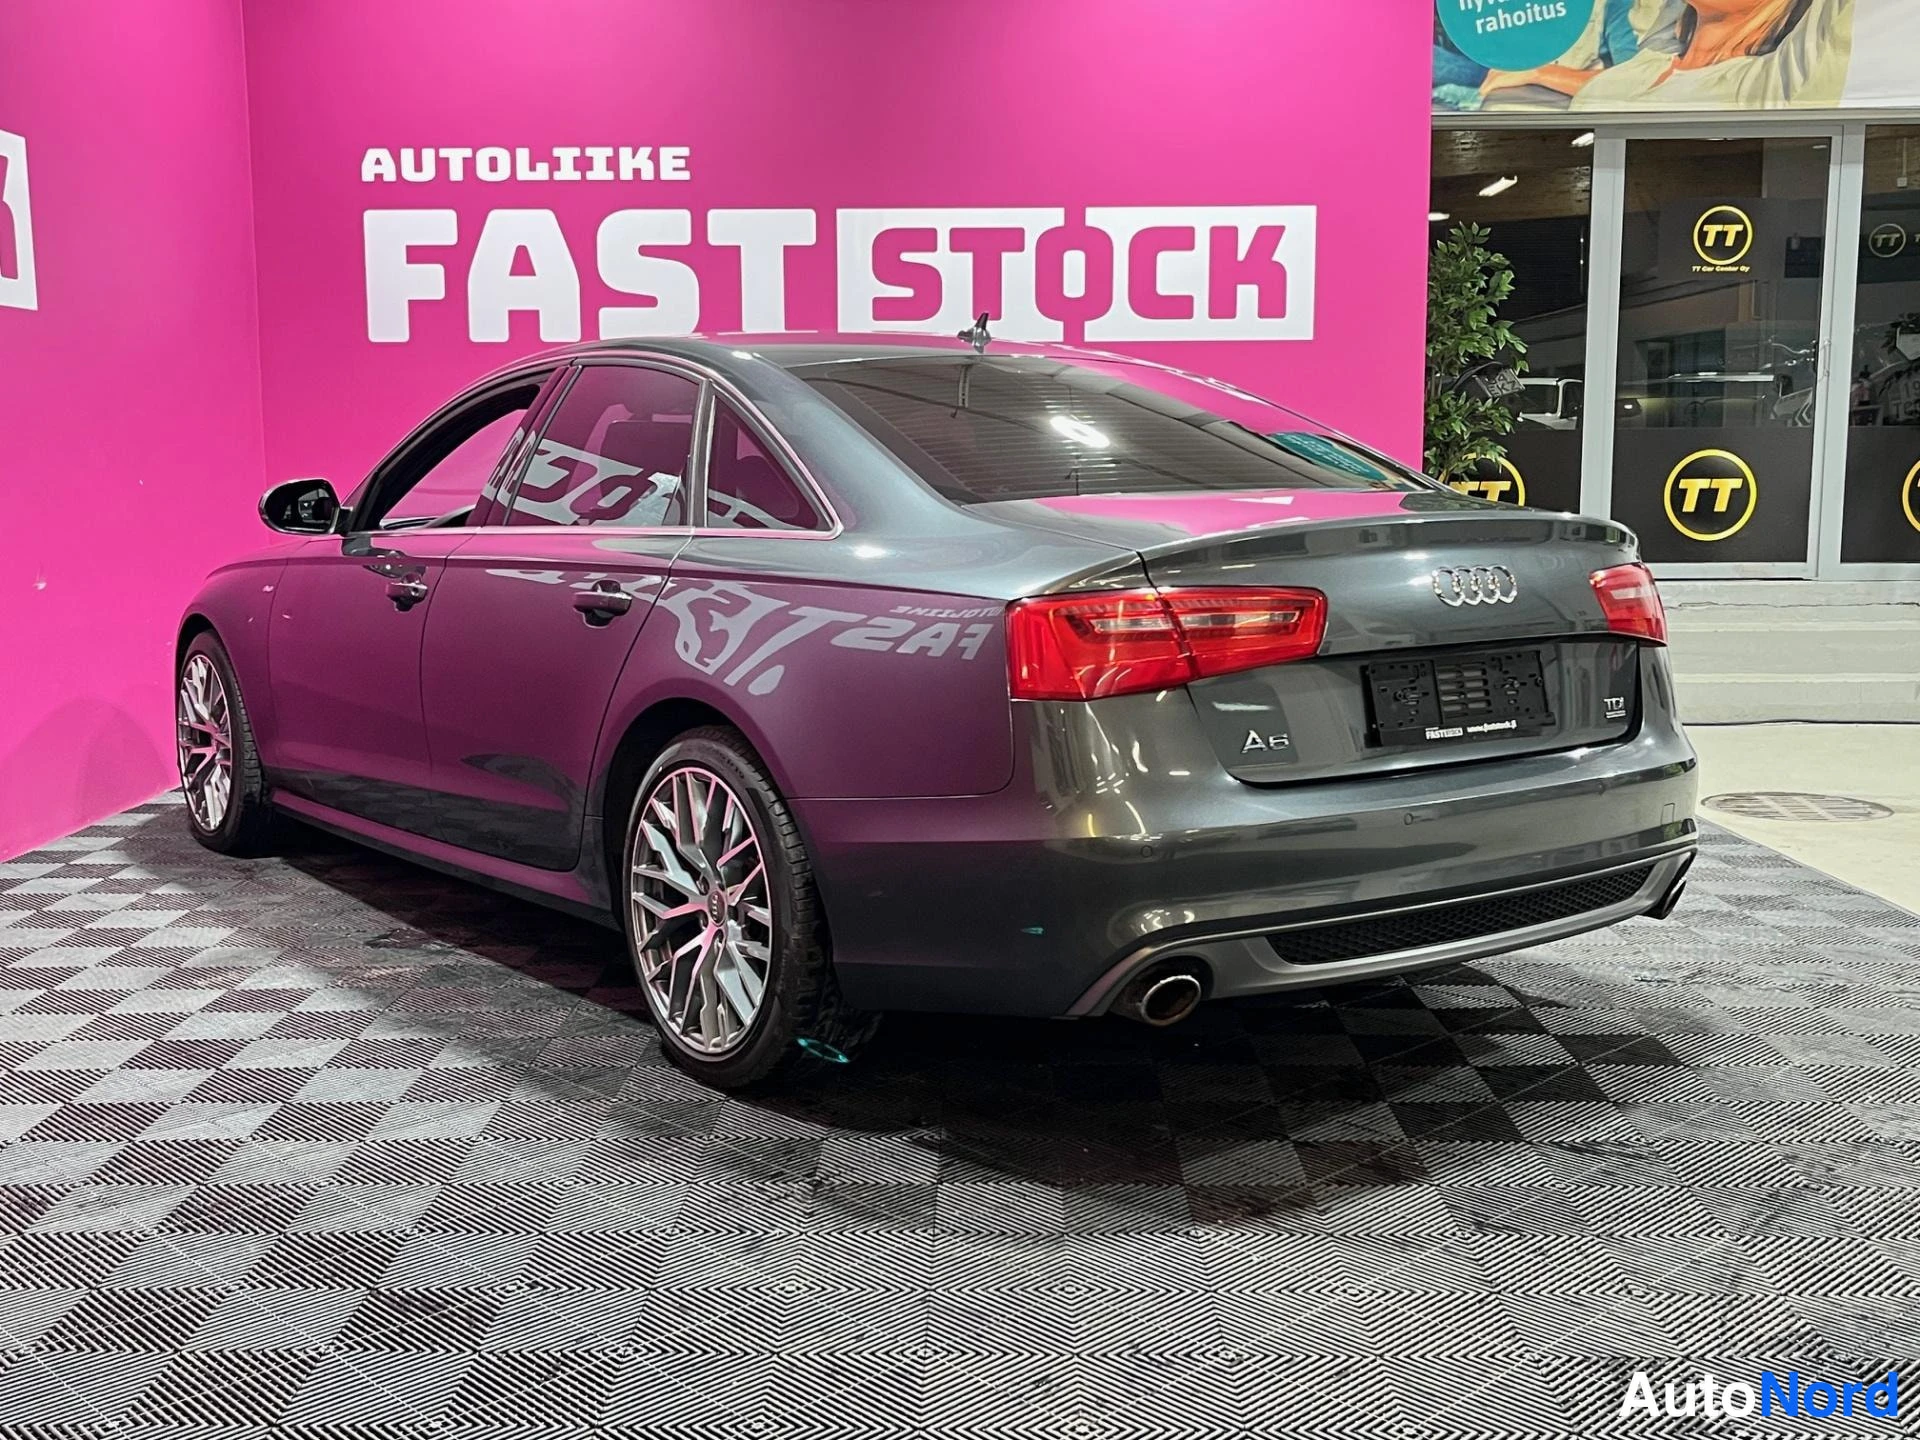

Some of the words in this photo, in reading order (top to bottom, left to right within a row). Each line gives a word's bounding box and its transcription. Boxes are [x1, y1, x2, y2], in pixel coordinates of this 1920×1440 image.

[1475, 1, 1567, 34] rahoitus
[361, 146, 691, 182] AUTOLIIKE
[1703, 224, 1744, 247] TT
[1874, 233, 1901, 248] TT
[363, 208, 817, 343] FAST
[872, 224, 1287, 323] STOCK
[1679, 478, 1743, 512] TT
[1603, 696, 1625, 710] TDI
[1241, 729, 1289, 753] A6
